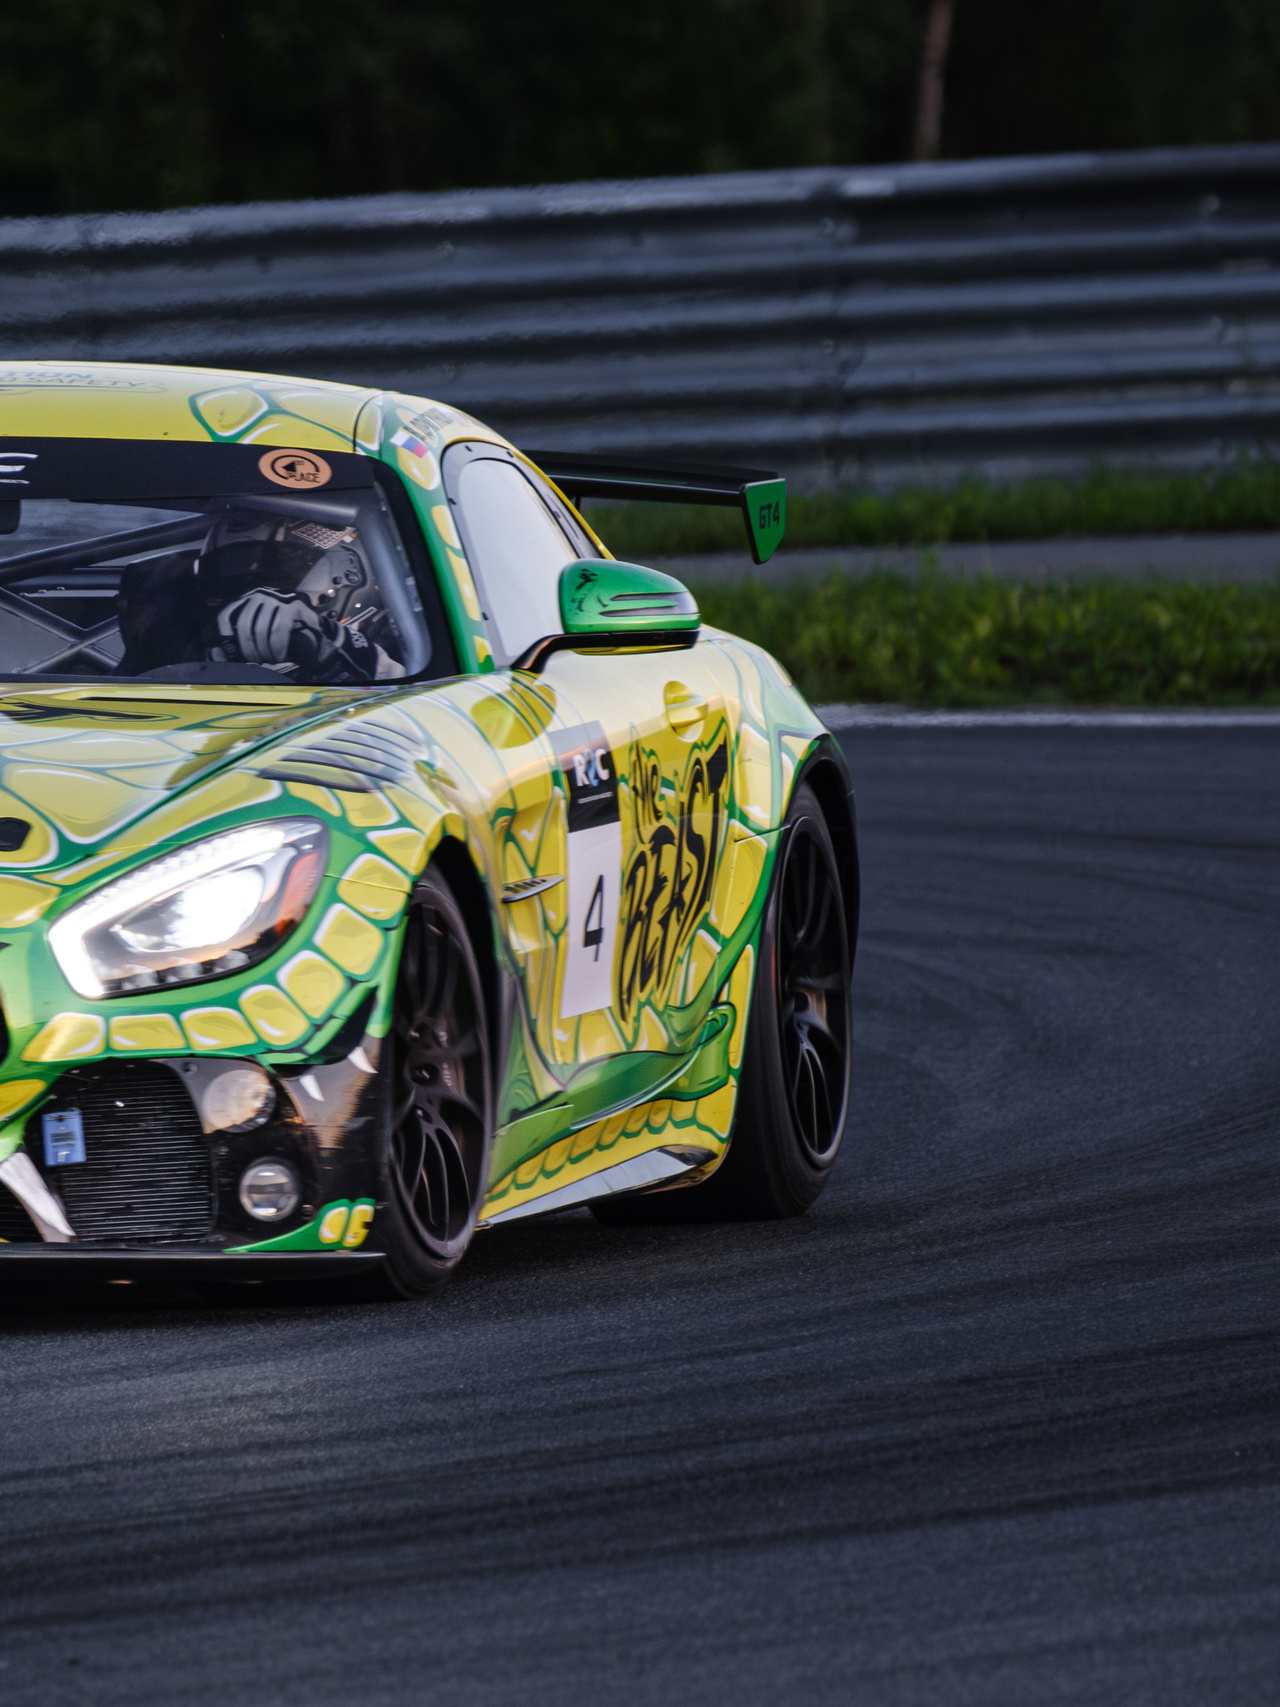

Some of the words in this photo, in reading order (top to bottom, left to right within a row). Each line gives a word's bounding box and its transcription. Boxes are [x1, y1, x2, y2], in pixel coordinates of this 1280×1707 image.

[28, 377, 147, 388] SAFETY
[759, 501, 780, 530] GT4
[583, 874, 604, 963] 4
